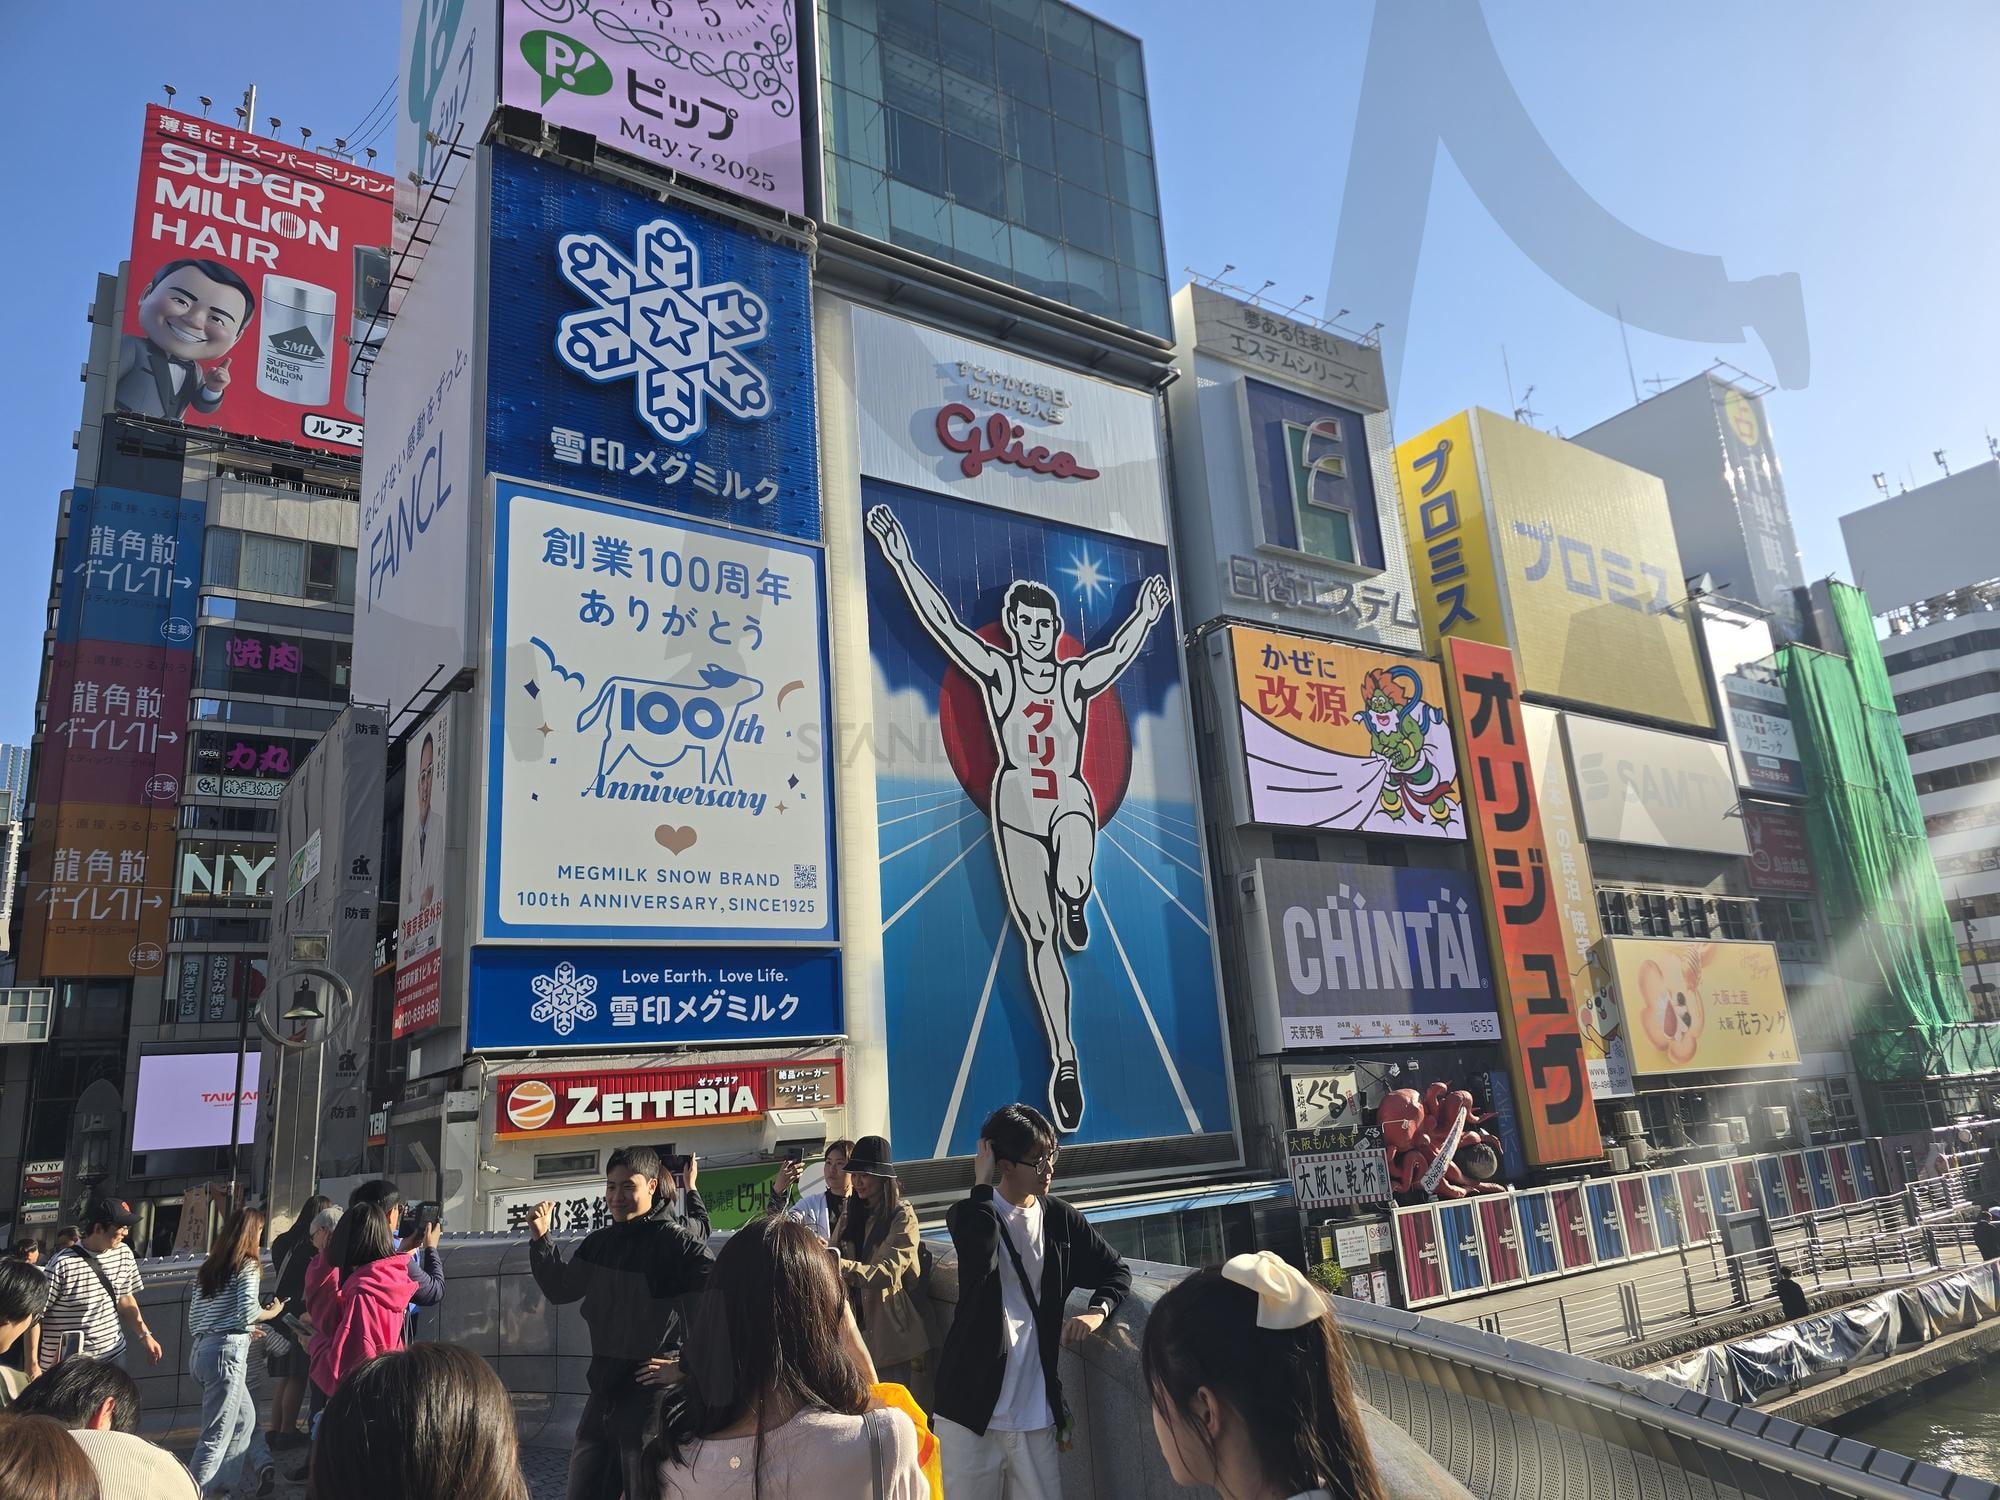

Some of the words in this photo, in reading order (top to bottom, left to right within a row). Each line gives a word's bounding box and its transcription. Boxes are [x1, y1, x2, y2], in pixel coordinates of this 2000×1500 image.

[627, 67, 740, 141] ピップ
[619, 115, 684, 159] May.
[711, 152, 777, 192] 2025
[158, 142, 325, 214] SUPER
[154, 176, 339, 252] MILLION
[151, 211, 280, 270] HAIR
[281, 340, 315, 356] SMH
[1243, 308, 1350, 356] 夢ある住まい
[264, 372, 290, 387] HAIR
[265, 364, 304, 382] MILLION
[266, 357, 301, 373] SUPER
[1230, 333, 1360, 393] エステムシリーズ
[936, 402, 1101, 480] Glico
[550, 425, 780, 506] 雪印メグミルク
[367, 429, 452, 614] FANCL
[1412, 438, 1479, 636] プロミス
[89, 525, 178, 566] 龍角散
[542, 526, 793, 607] 創業100周年
[1513, 519, 1684, 626] プロミス
[163, 623, 190, 636] 生薬
[578, 588, 764, 652] ありがとう
[224, 636, 304, 673] 焼肉
[1260, 643, 1337, 679] かぜに
[71, 680, 165, 719] 龍角散
[1255, 674, 1351, 727] 改源
[355, 722, 381, 736] 防音
[1744, 735, 1783, 755] クリニック
[199, 749, 219, 758] OPEN
[225, 742, 291, 773] 力丸
[1022, 698, 1058, 800] グリコ
[148, 780, 176, 793] 生薬
[580, 773, 768, 816] Anniversary
[53, 847, 150, 884] 龍角散
[181, 853, 277, 896] NY
[557, 864, 648, 882] MEGMILK
[656, 868, 712, 885] SNOW
[719, 871, 781, 887] BRAND
[344, 906, 372, 920] 防音
[516, 890, 571, 908] 100th
[131, 949, 161, 962] 生薬
[1282, 884, 1481, 995] CHINTAI
[180, 961, 201, 1016] 焼きそば
[210, 953, 228, 1020] お好み焼き
[622, 968, 660, 985] Love
[663, 967, 713, 985] Earth.
[719, 967, 756, 983] Love
[757, 967, 789, 983] Life.
[609, 988, 800, 1027] 雪印メグミルク
[1290, 1025, 1324, 1041] 天気予報
[697, 1075, 739, 1087] ゼッテリア
[778, 1068, 831, 1081] 絶品バーガー
[1483, 1072, 1492, 1102] 2F
[330, 1105, 359, 1119] 防音
[565, 1085, 758, 1125] ZETTERIA
[795, 1091, 831, 1103] コーヒー
[1306, 1079, 1347, 1118] くくる
[1290, 1131, 1358, 1152] 大阪もんを食す
[31, 1164, 45, 1172] NY
[47, 1162, 61, 1171] NY
[1298, 1159, 1377, 1200] 大阪に乾杯
